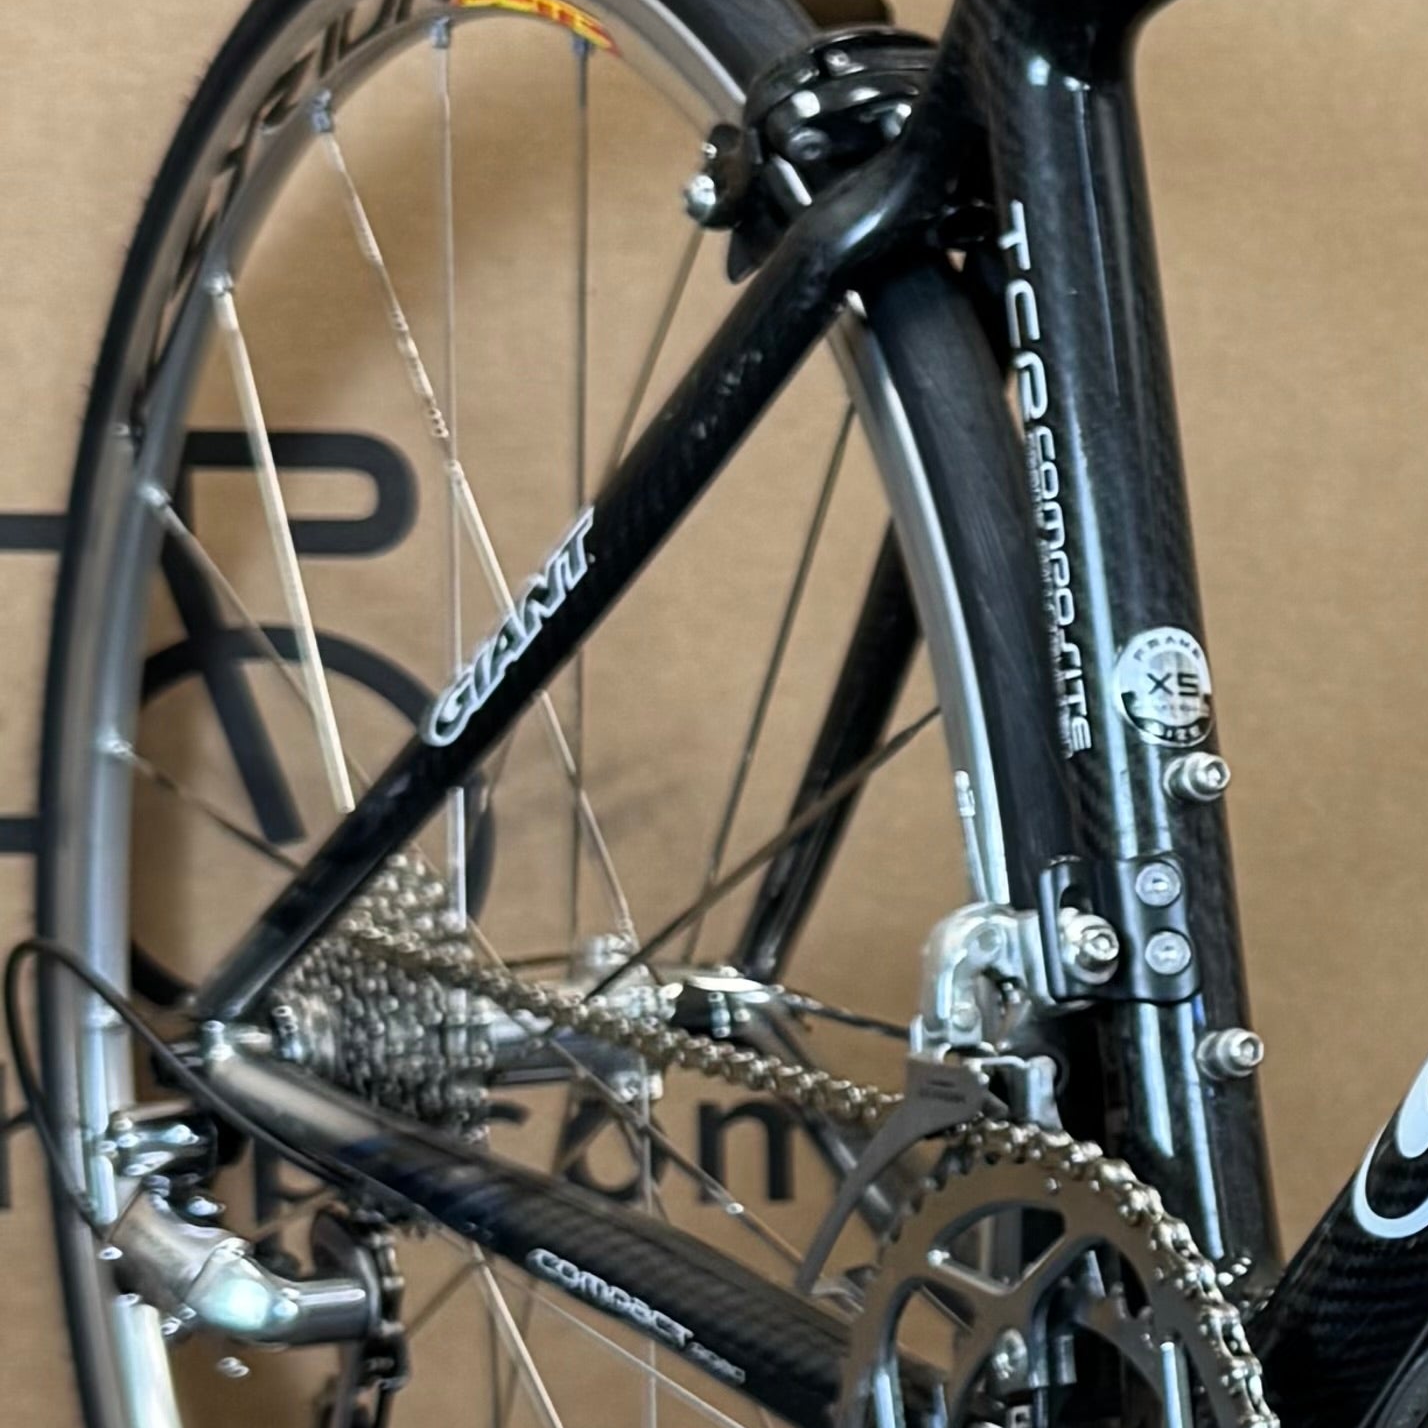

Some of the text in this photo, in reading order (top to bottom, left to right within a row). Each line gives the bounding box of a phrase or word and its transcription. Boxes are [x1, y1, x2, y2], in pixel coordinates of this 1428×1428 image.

[997, 199, 1049, 425] TCR
[424, 505, 595, 747] GIANT
[1145, 671, 1200, 698] XS
